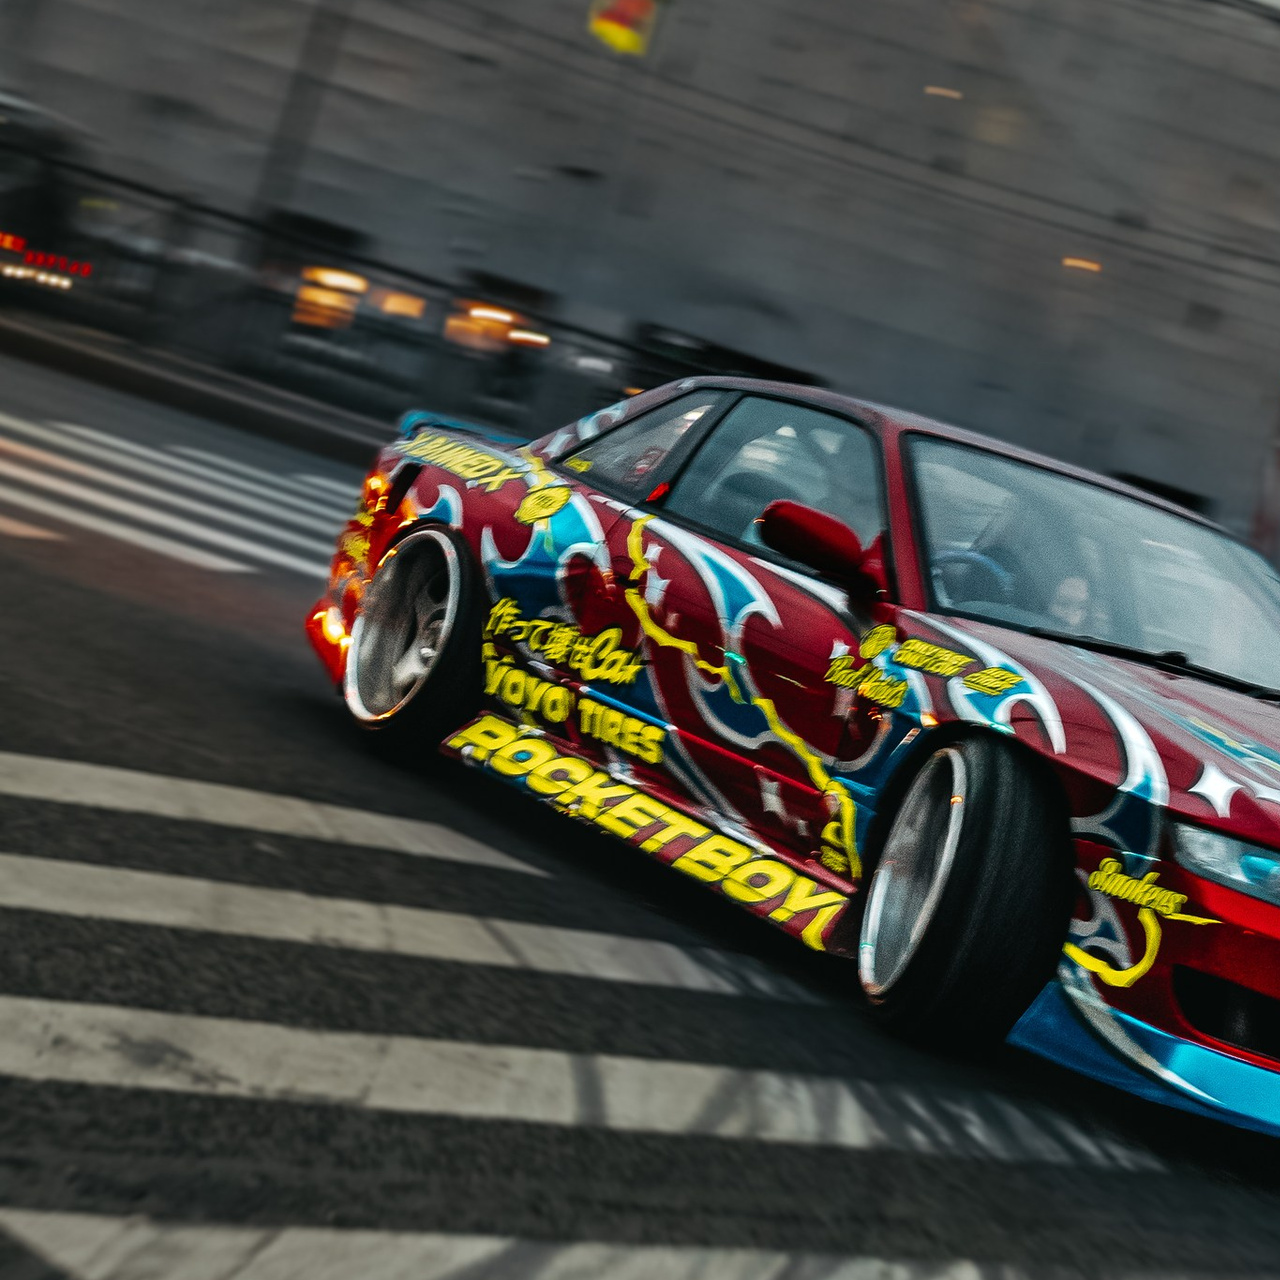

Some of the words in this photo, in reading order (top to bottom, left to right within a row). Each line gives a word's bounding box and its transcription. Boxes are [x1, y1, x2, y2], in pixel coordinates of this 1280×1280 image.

[484, 660, 572, 724] YOYO
[577, 698, 667, 764] TIRES
[448, 716, 850, 924] ROCKETBOY
